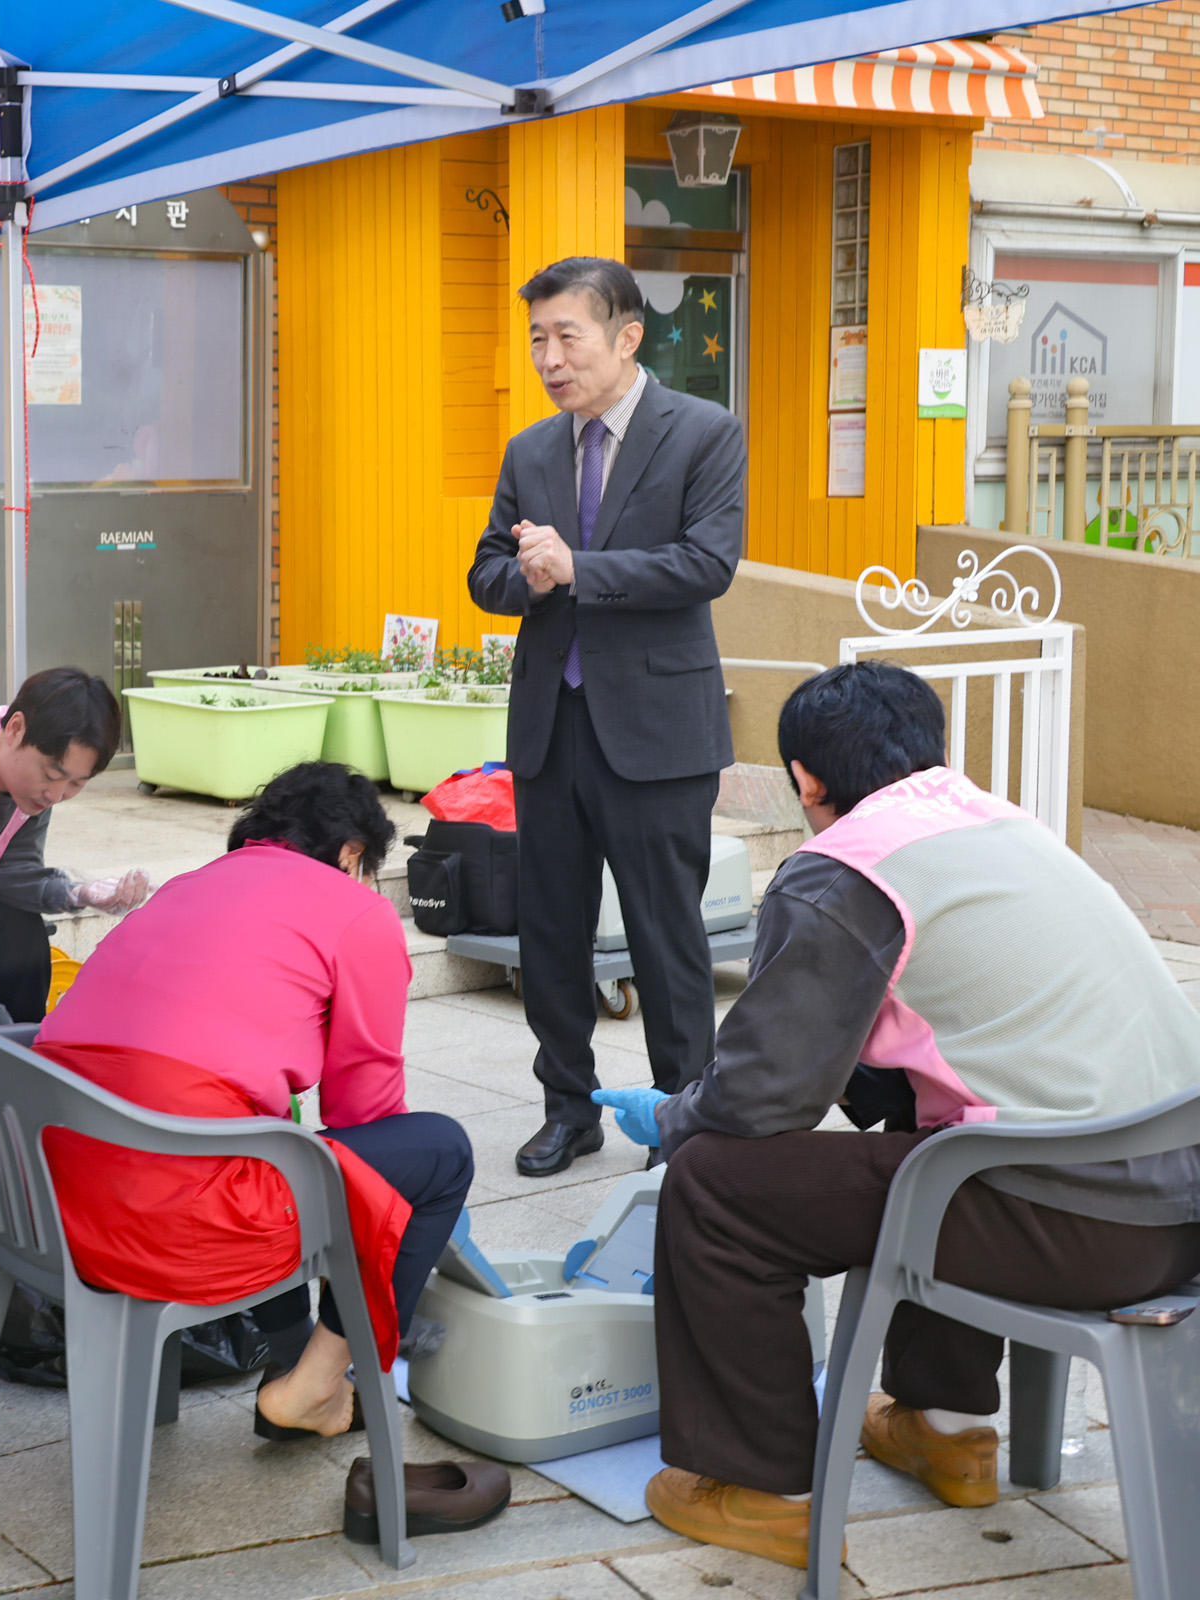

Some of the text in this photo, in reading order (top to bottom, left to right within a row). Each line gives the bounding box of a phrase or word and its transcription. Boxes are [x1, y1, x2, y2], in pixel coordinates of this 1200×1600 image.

[1069, 356, 1097, 374] KCA
[100, 531, 154, 544] RAEMIAN
[569, 1391, 620, 1414] SONOST
[622, 1383, 652, 1401] 3000
